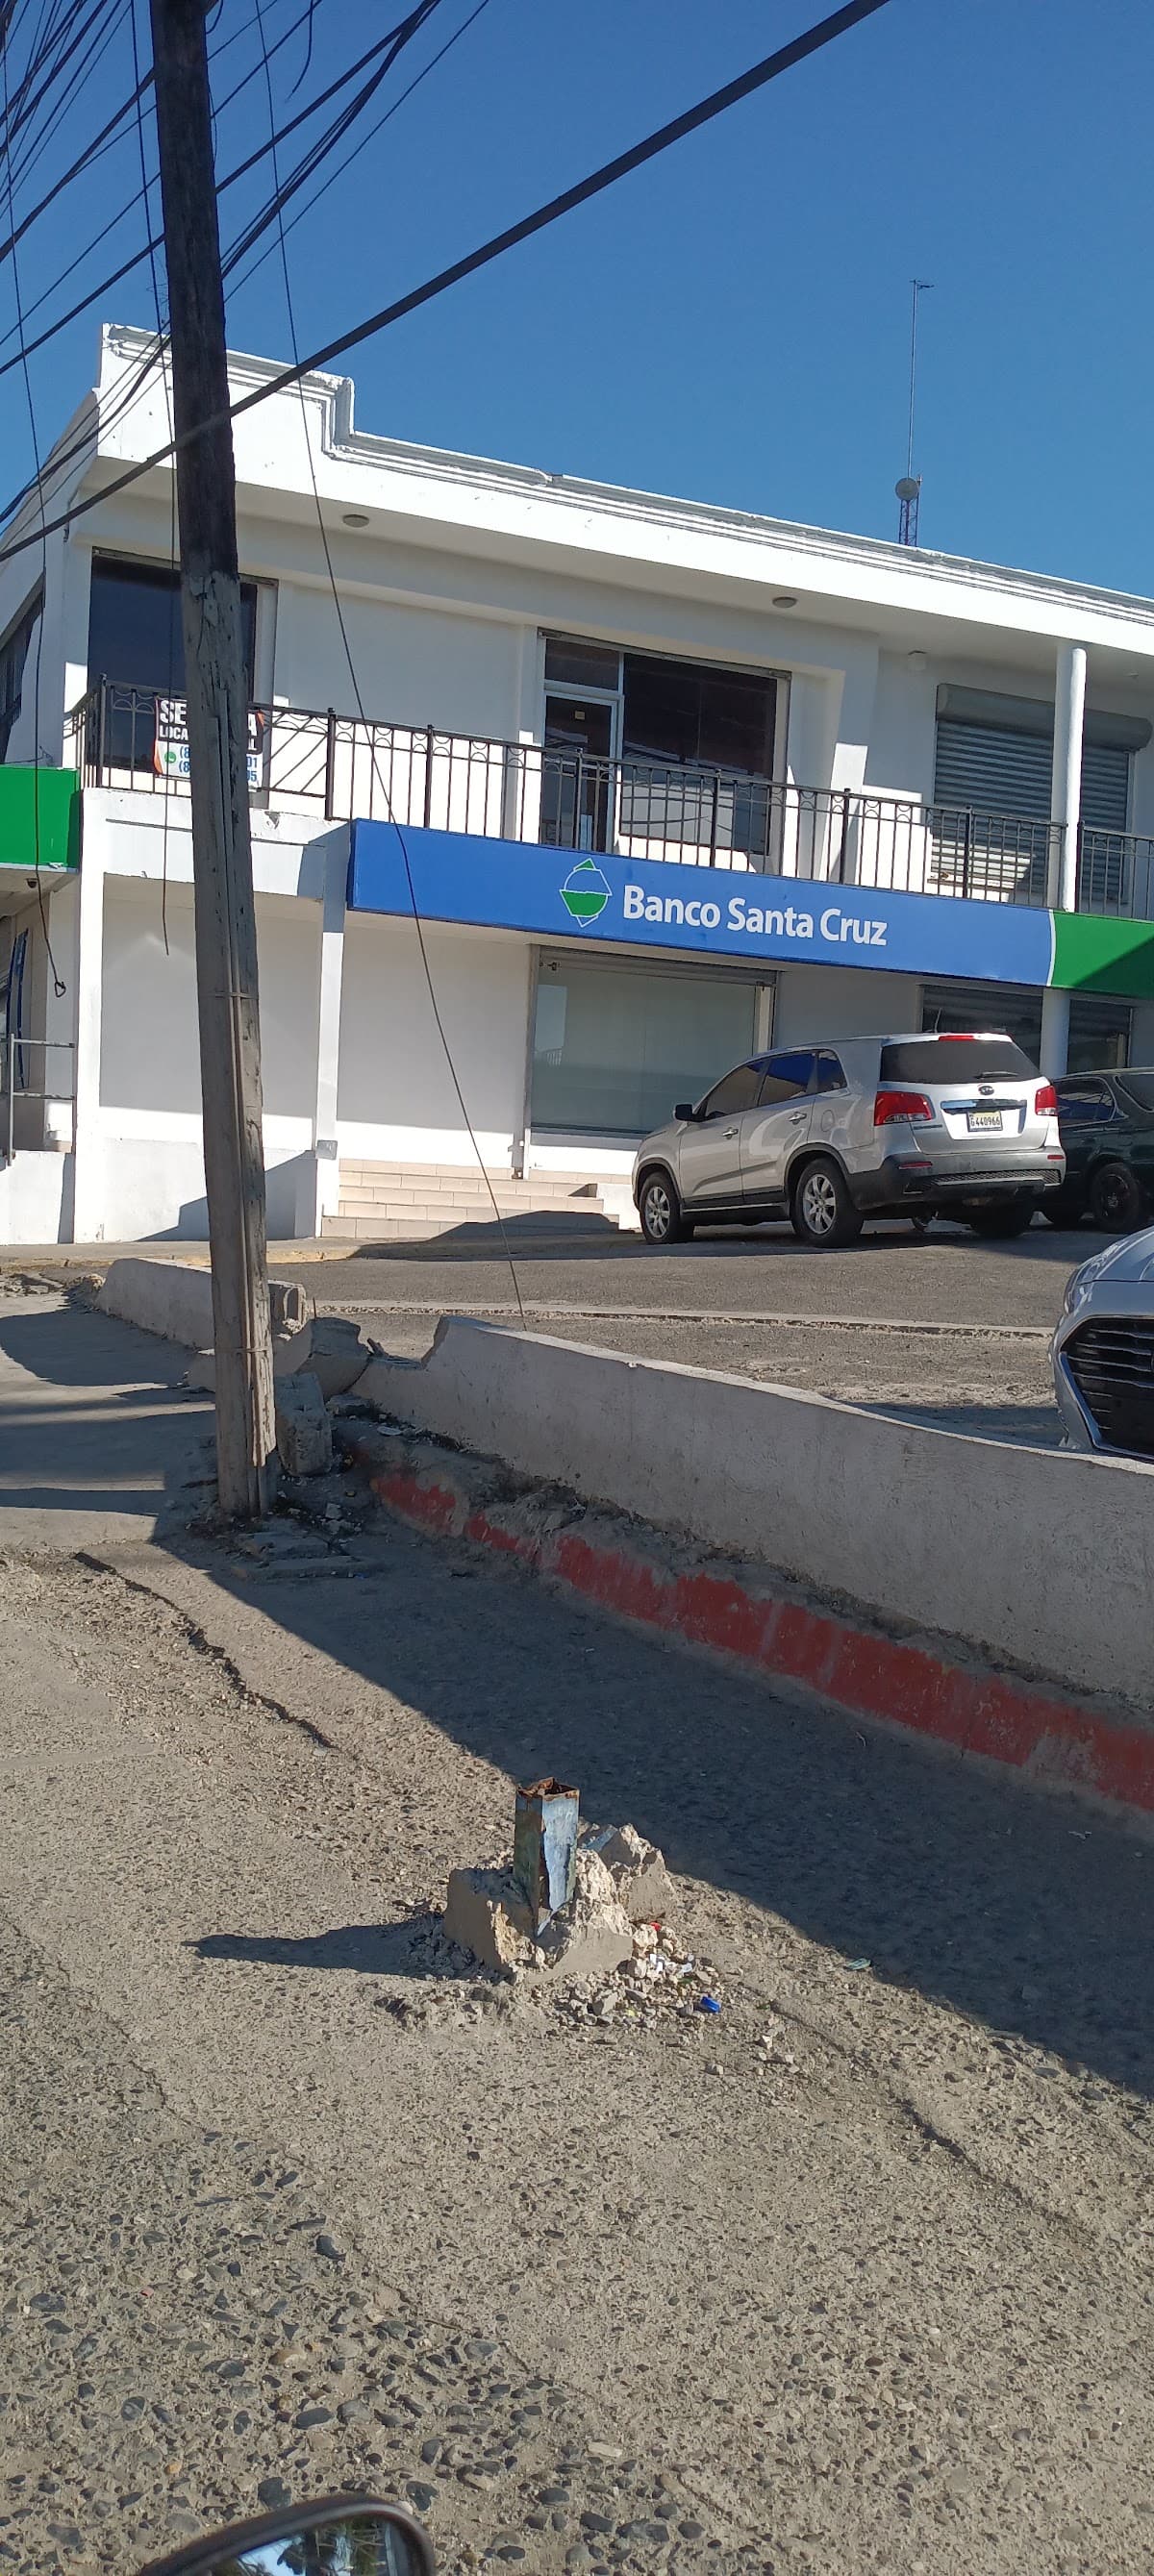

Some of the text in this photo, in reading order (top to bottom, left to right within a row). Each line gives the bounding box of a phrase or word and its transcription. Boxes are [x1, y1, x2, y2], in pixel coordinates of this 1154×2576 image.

[159, 725, 188, 740] LOCA
[623, 885, 889, 946] Banco Santa Cruz
